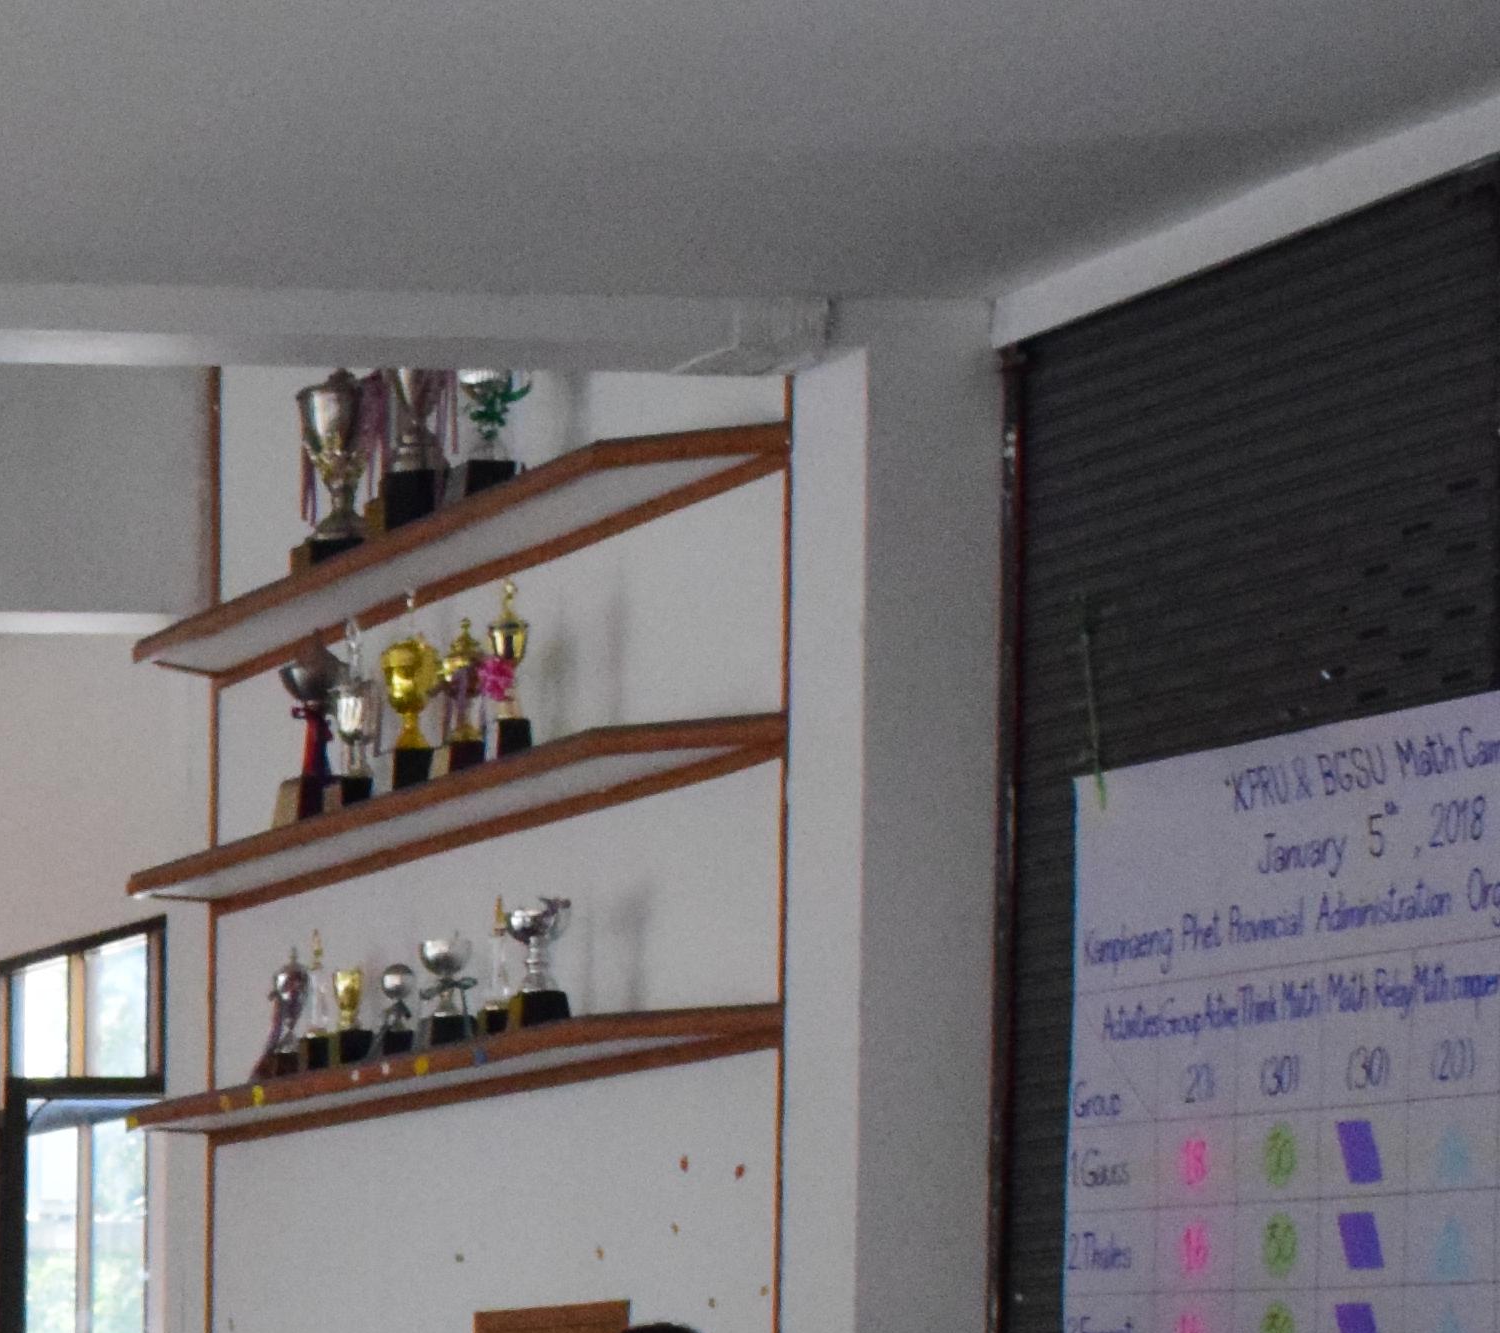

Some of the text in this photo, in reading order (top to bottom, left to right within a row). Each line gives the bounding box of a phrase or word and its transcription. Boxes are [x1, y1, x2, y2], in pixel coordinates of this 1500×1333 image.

[1316, 746, 1388, 796] BGSU
[1394, 733, 1458, 779] Math
[1258, 832, 1347, 878] January
